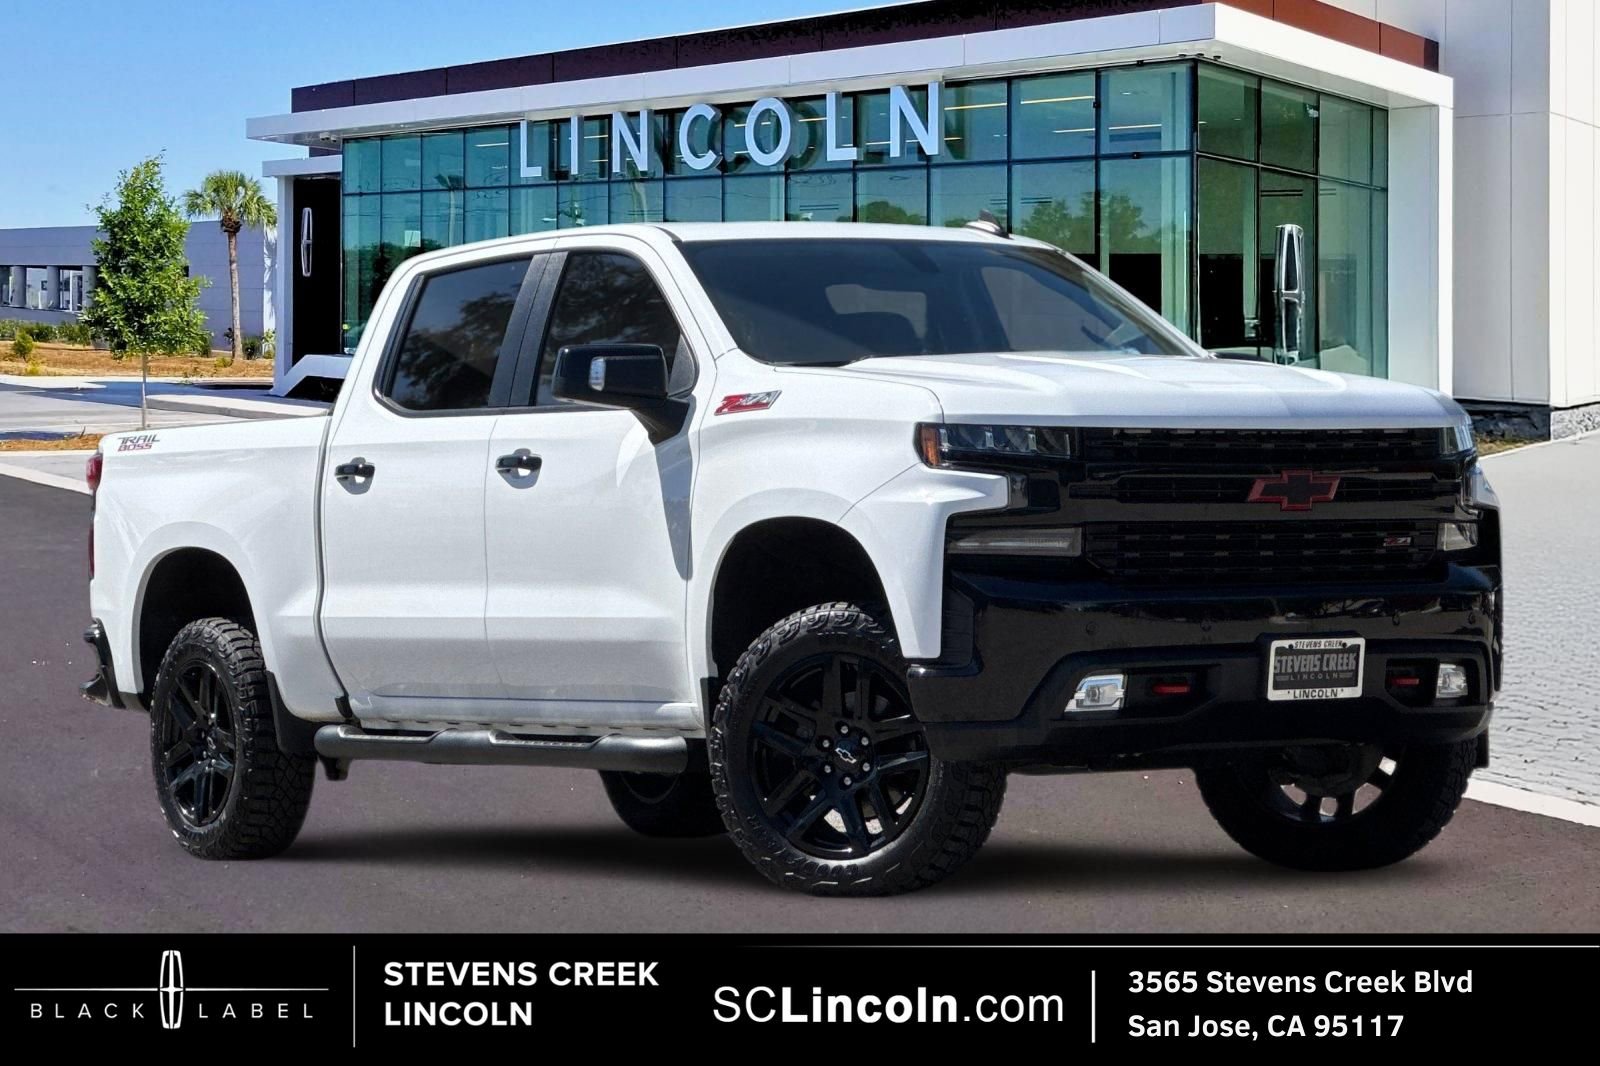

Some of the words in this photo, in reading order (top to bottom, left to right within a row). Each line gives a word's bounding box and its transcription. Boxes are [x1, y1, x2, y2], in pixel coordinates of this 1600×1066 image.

[520, 81, 941, 178] LINCOLN
[117, 434, 160, 445] TRAIL
[118, 443, 153, 452] BOSS
[1294, 640, 1322, 648] STEVENS
[1323, 640, 1343, 648] CREEK
[1274, 654, 1322, 674] STEVENS
[1322, 652, 1357, 672] CREEK
[1290, 672, 1338, 681] LINCOLN
[1293, 689, 1338, 699] LINCOLN
